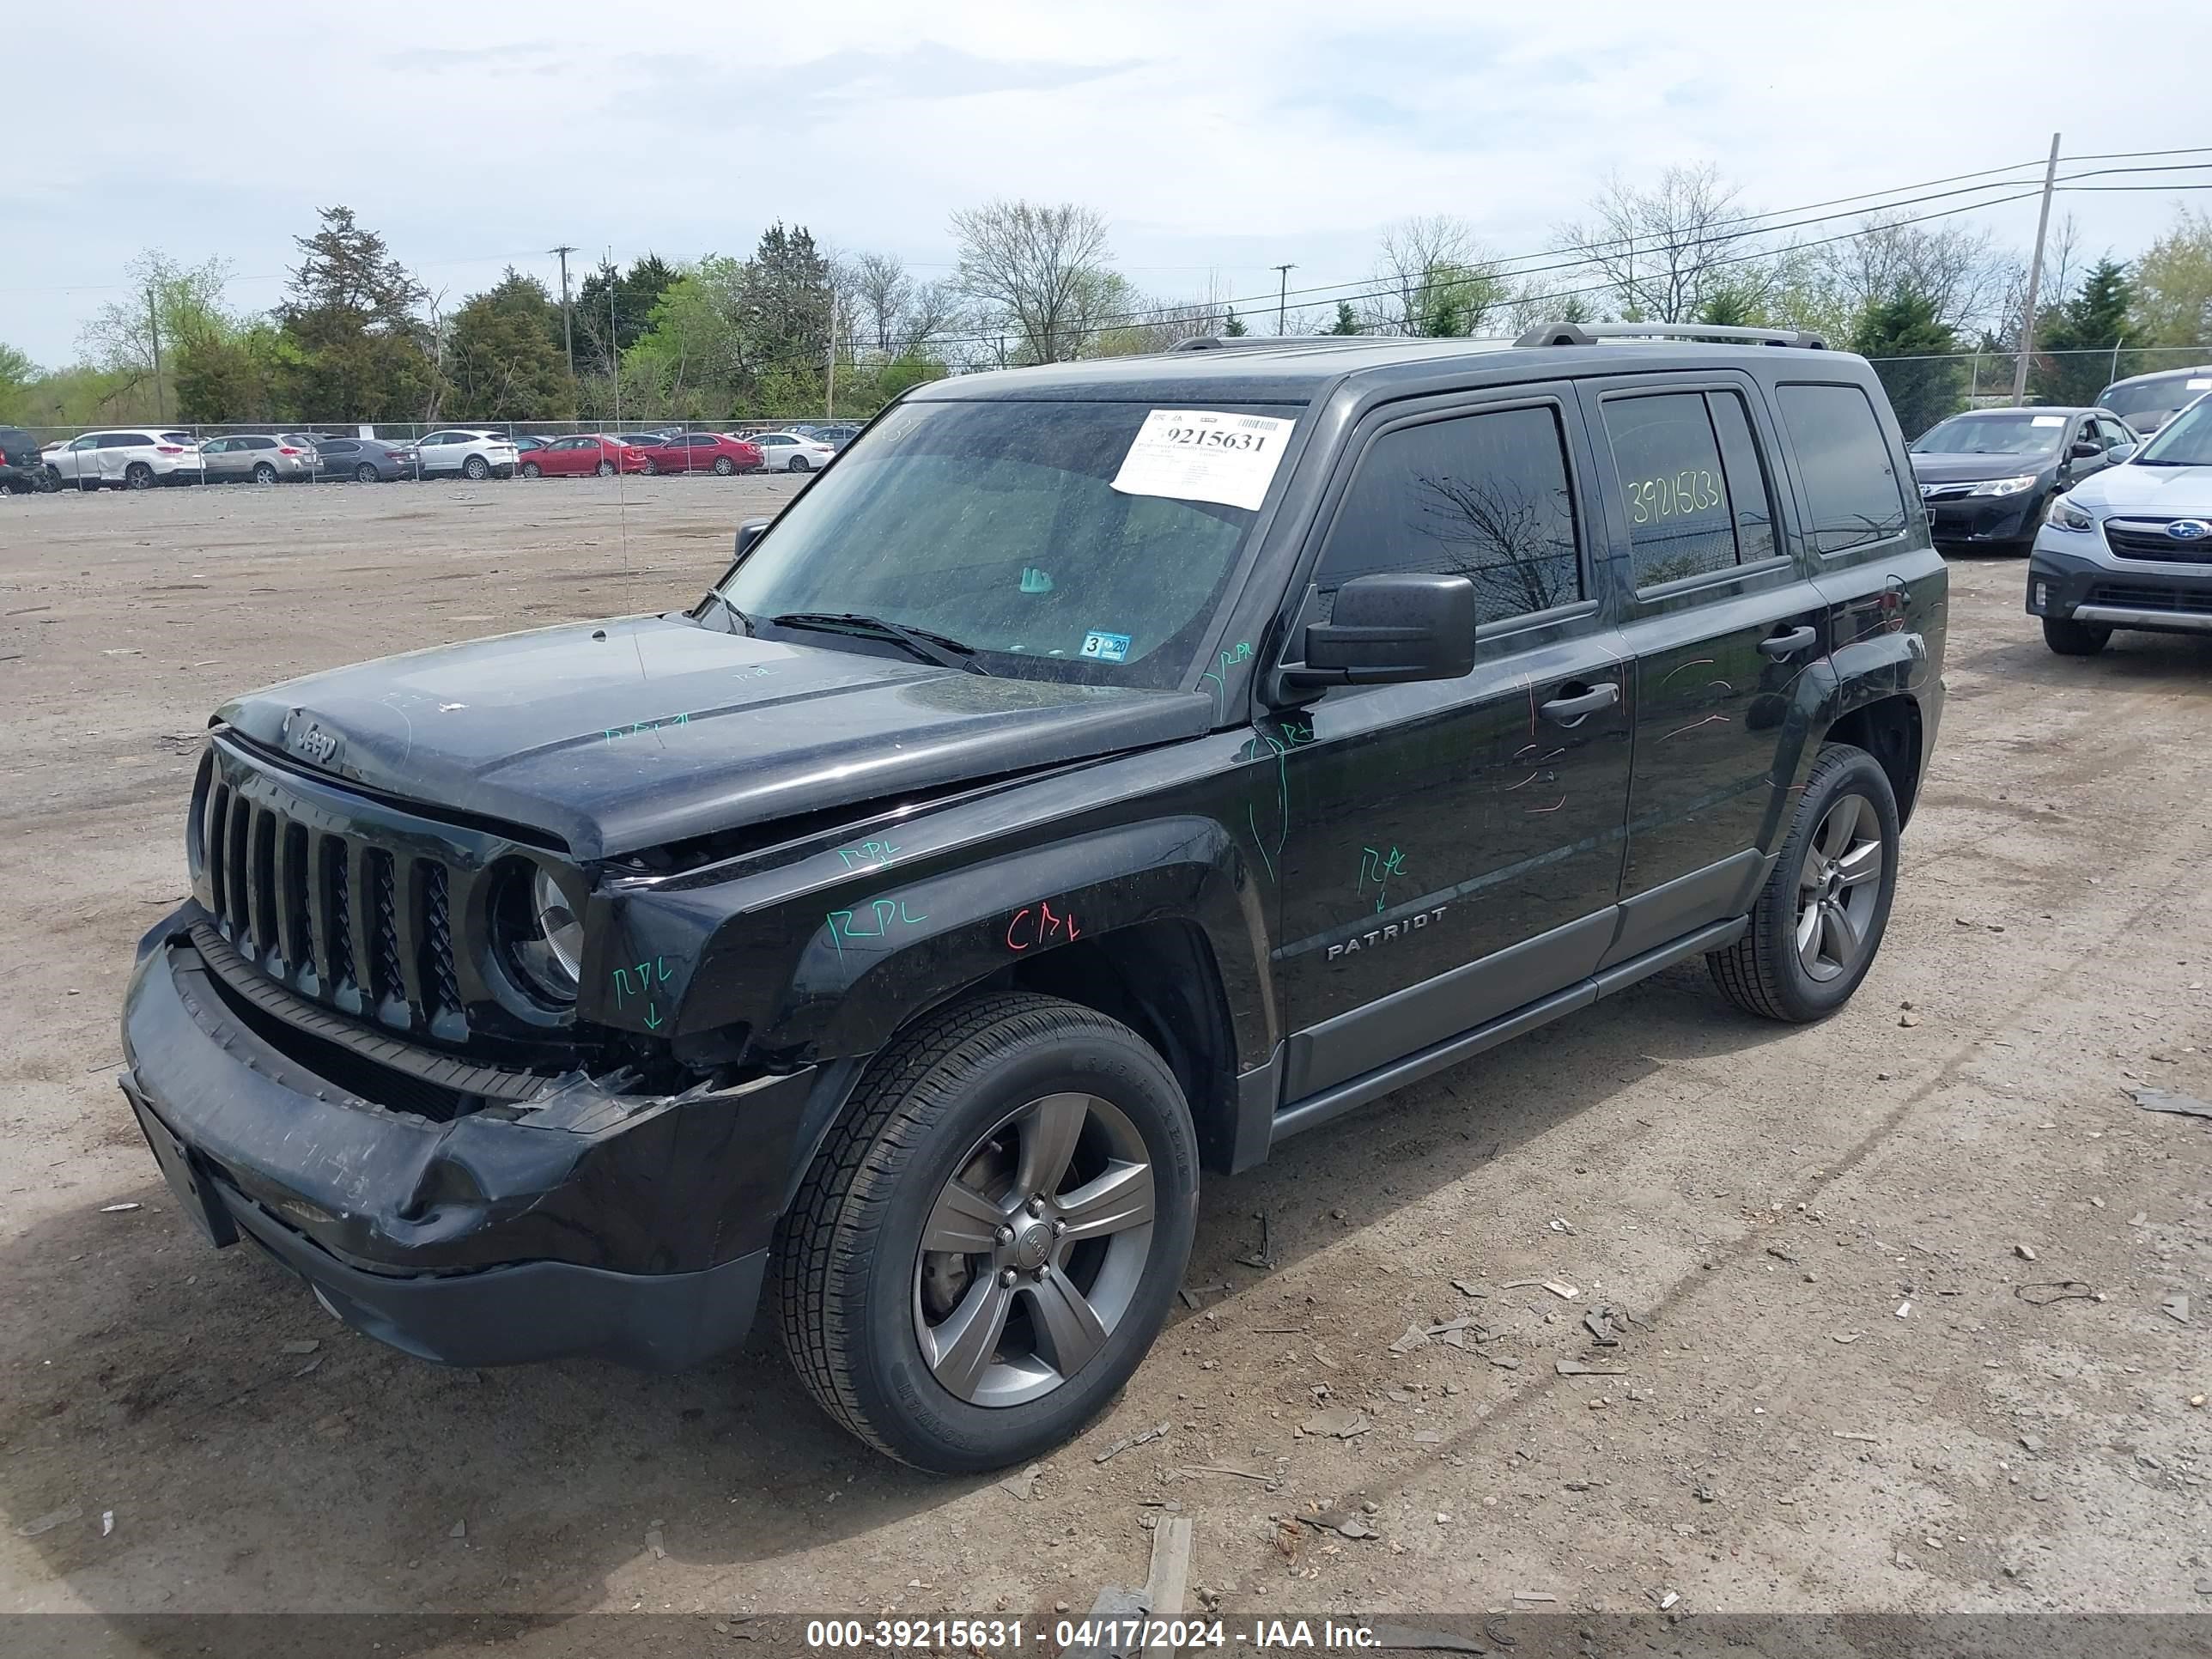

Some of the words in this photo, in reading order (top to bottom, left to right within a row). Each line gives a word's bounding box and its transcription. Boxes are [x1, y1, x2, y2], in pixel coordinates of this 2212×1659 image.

[1628, 471, 1725, 524] 39215631
[1086, 637, 1099, 653] 3
[1113, 641, 1127, 653] 20
[297, 721, 337, 763] Jeep
[1327, 906, 1448, 961] PATRIOT
